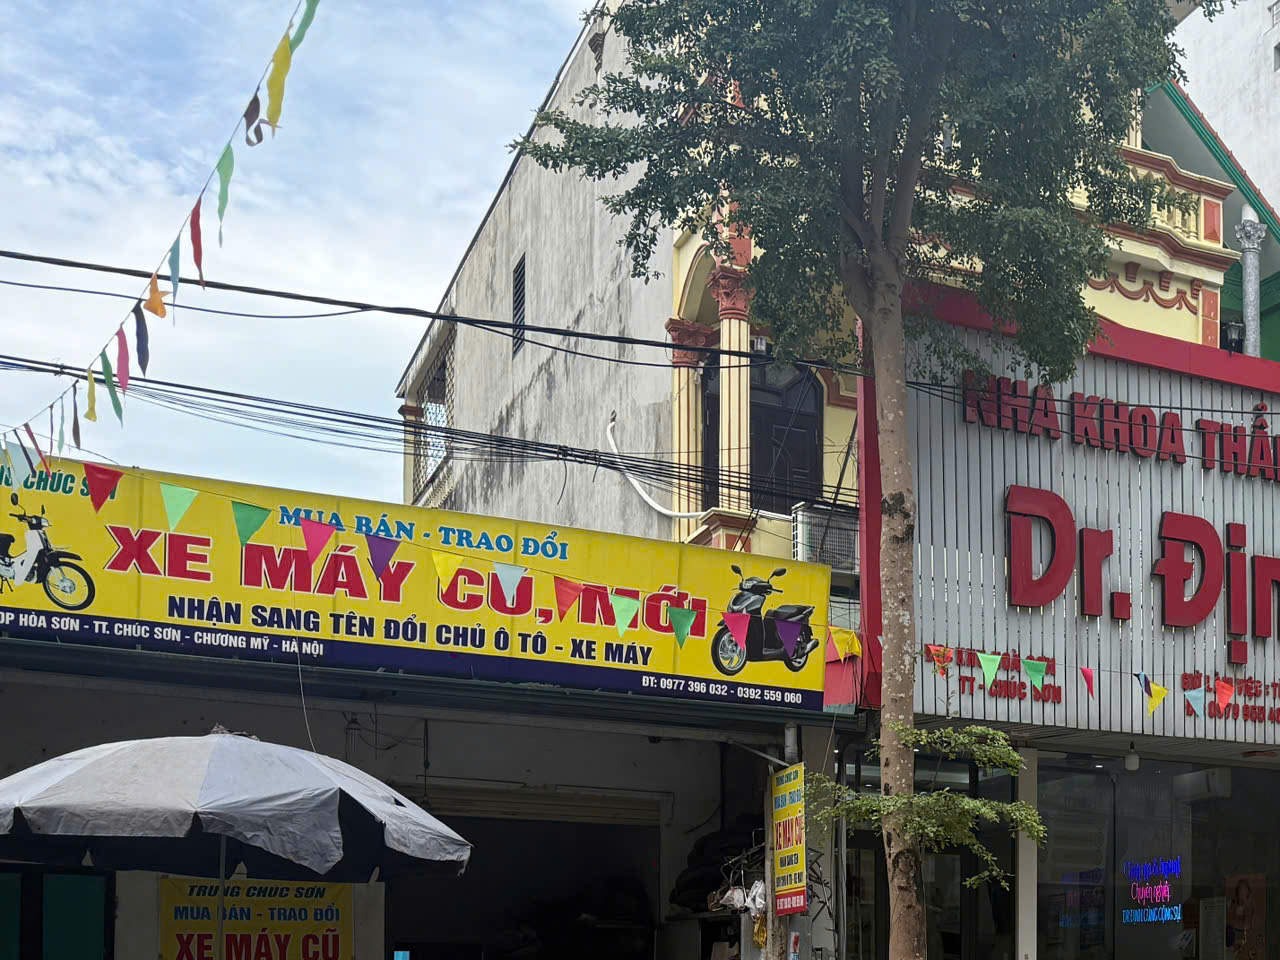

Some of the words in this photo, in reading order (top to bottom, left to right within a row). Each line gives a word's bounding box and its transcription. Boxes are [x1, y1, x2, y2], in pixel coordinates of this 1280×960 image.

[1070, 392, 1187, 464] KHOA
[279, 506, 344, 532] MUA
[356, 513, 416, 541] BÁN
[438, 526, 514, 553] TRAO
[521, 530, 569, 560] ĐỔI
[1006, 484, 1132, 621] Dr.
[105, 524, 214, 583] XE
[242, 542, 416, 603] MÁY
[579, 583, 708, 639] MỚI
[19, 611, 47, 628] HÒA
[51, 616, 80, 631] SƠN
[93, 621, 110, 635] TT.
[114, 622, 150, 638] CHÚC
[154, 627, 181, 642] SƠN
[194, 630, 246, 649] CHƯƠNG
[250, 634, 270, 650] MỸ
[282, 637, 298, 654] HÀ
[301, 639, 324, 656] NỘI
[168, 596, 242, 627] NHẬN
[252, 605, 321, 633] SANG
[330, 611, 375, 638] TÊN
[384, 613, 428, 645] ĐỔI
[436, 623, 486, 649] CHỦ
[494, 627, 510, 651] Ô
[518, 631, 547, 655] TÔ
[570, 638, 597, 661] XE
[604, 642, 652, 666] MÁY
[642, 676, 658, 689] ĐT:
[660, 678, 684, 692] 0977
[687, 680, 707, 693] 396
[709, 682, 727, 695] 032
[737, 685, 761, 699] 0392
[763, 688, 782, 701] 559
[784, 690, 802, 703] 060
[960, 675, 976, 695] TT
[989, 676, 1026, 701] CHÚC
[174, 906, 211, 920] MUA
[268, 907, 308, 921] TRAO
[313, 903, 340, 921] ĐỔI
[294, 885, 326, 898] SƠN
